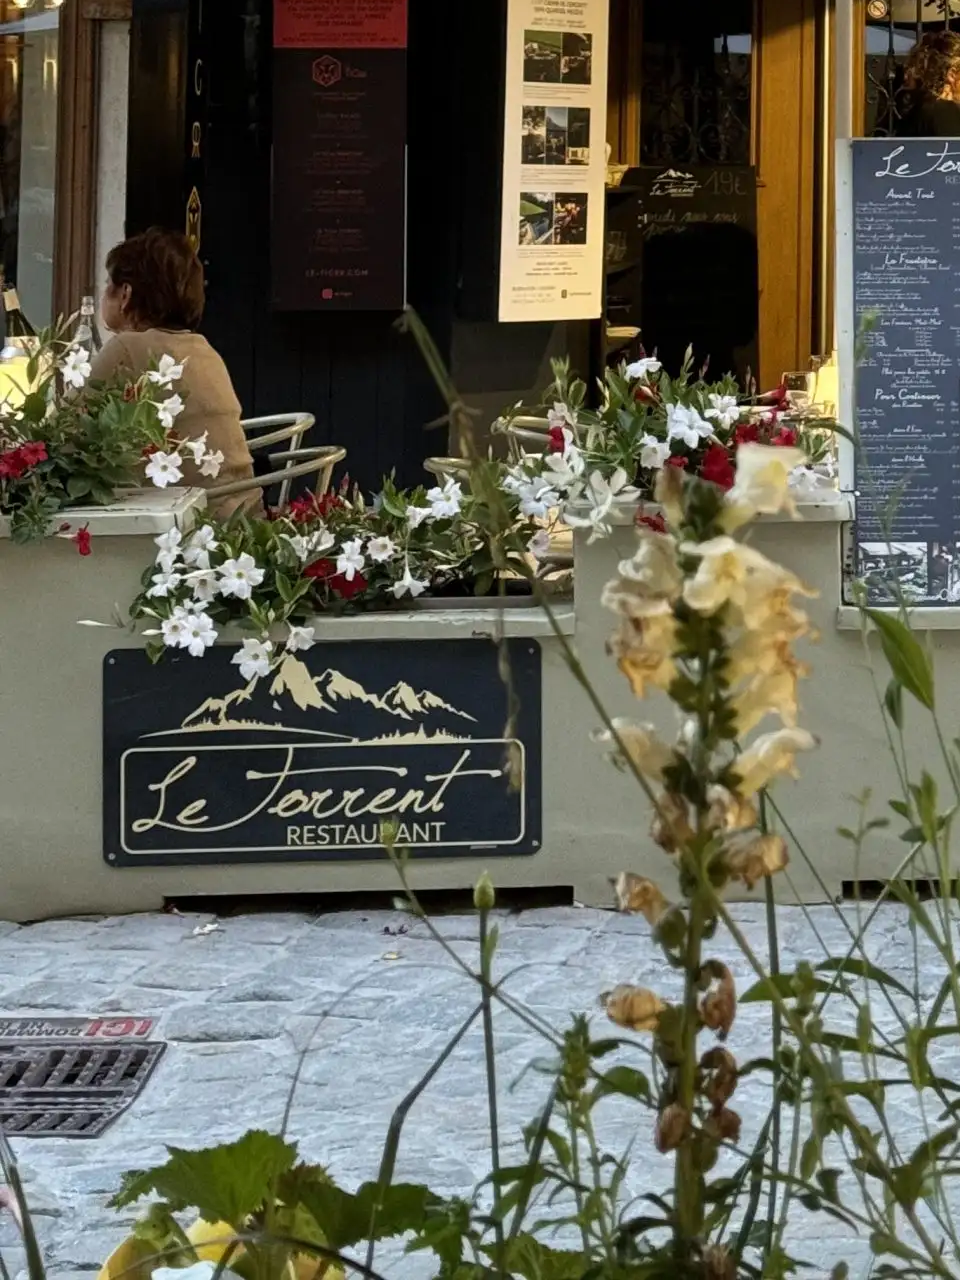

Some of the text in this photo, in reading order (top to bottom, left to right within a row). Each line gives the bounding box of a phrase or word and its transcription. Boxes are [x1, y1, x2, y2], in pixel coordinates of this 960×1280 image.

[875, 145, 910, 177] Le
[132, 747, 502, 834] Le Torrent
